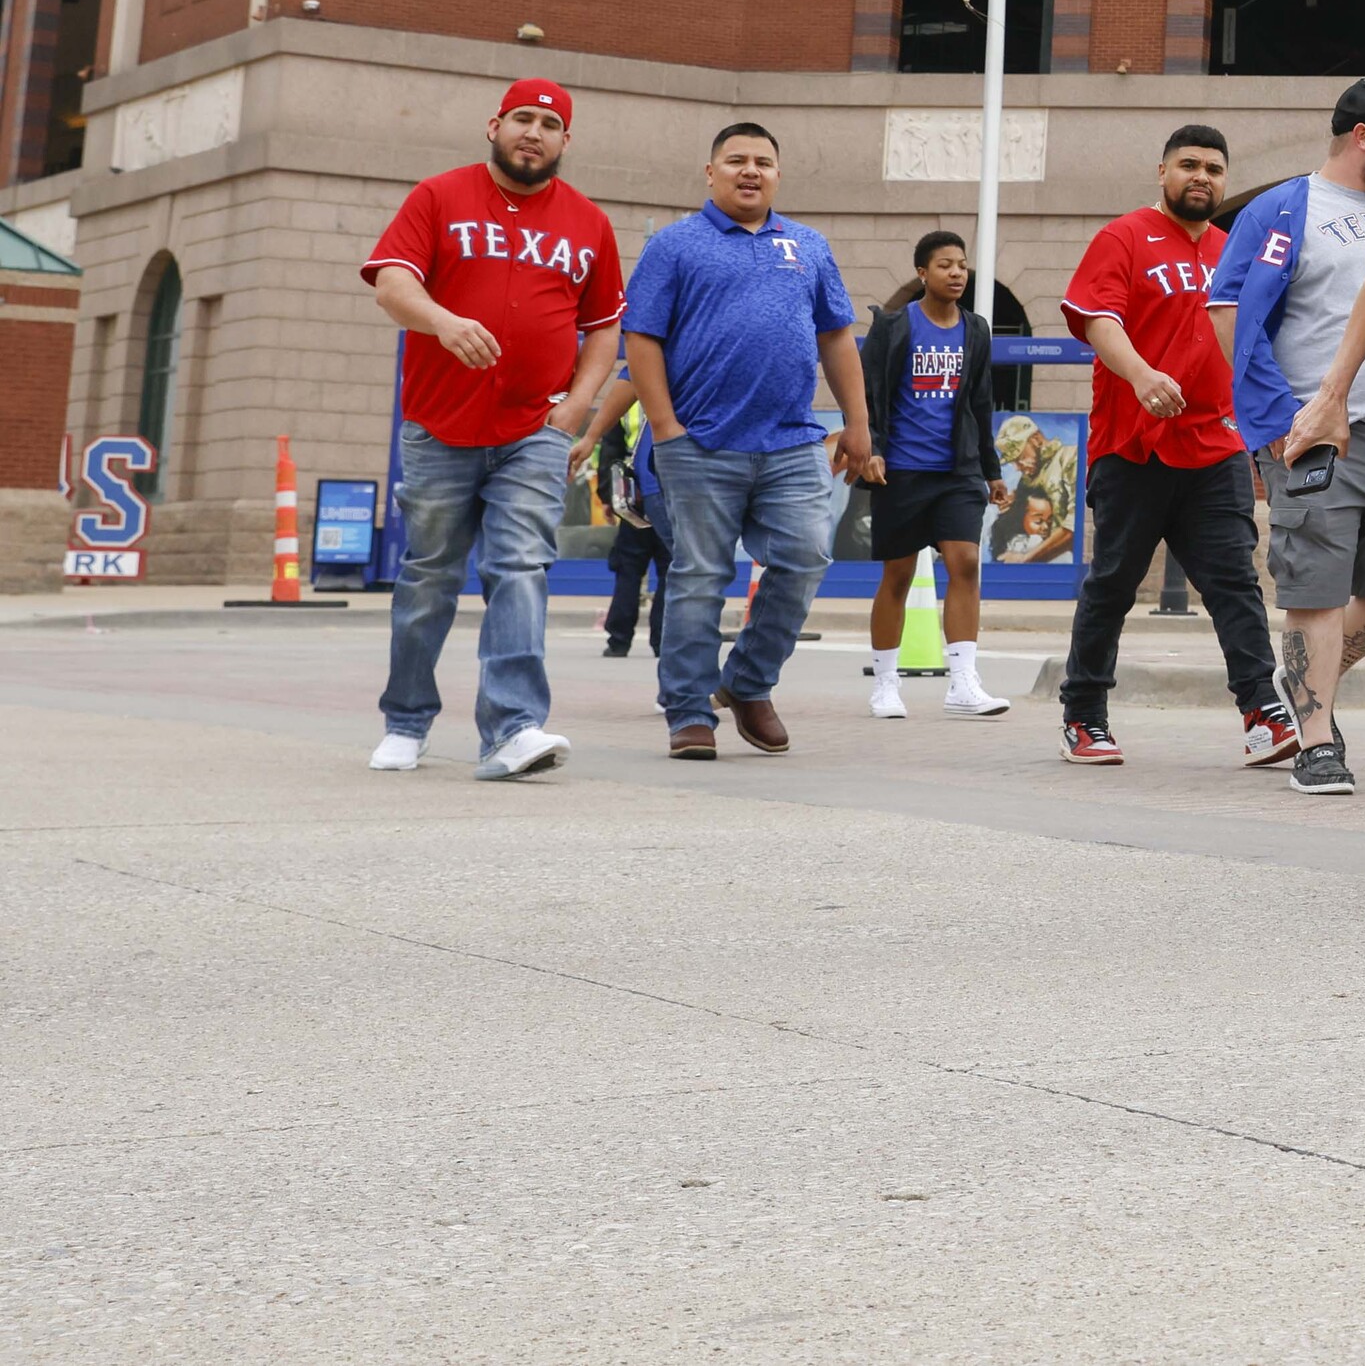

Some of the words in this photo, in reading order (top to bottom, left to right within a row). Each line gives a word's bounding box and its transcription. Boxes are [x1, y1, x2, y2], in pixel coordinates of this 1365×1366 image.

[449, 220, 596, 285] TEXAS
[771, 237, 799, 263] T
[1258, 229, 1293, 267] E
[58, 434, 155, 547] S
